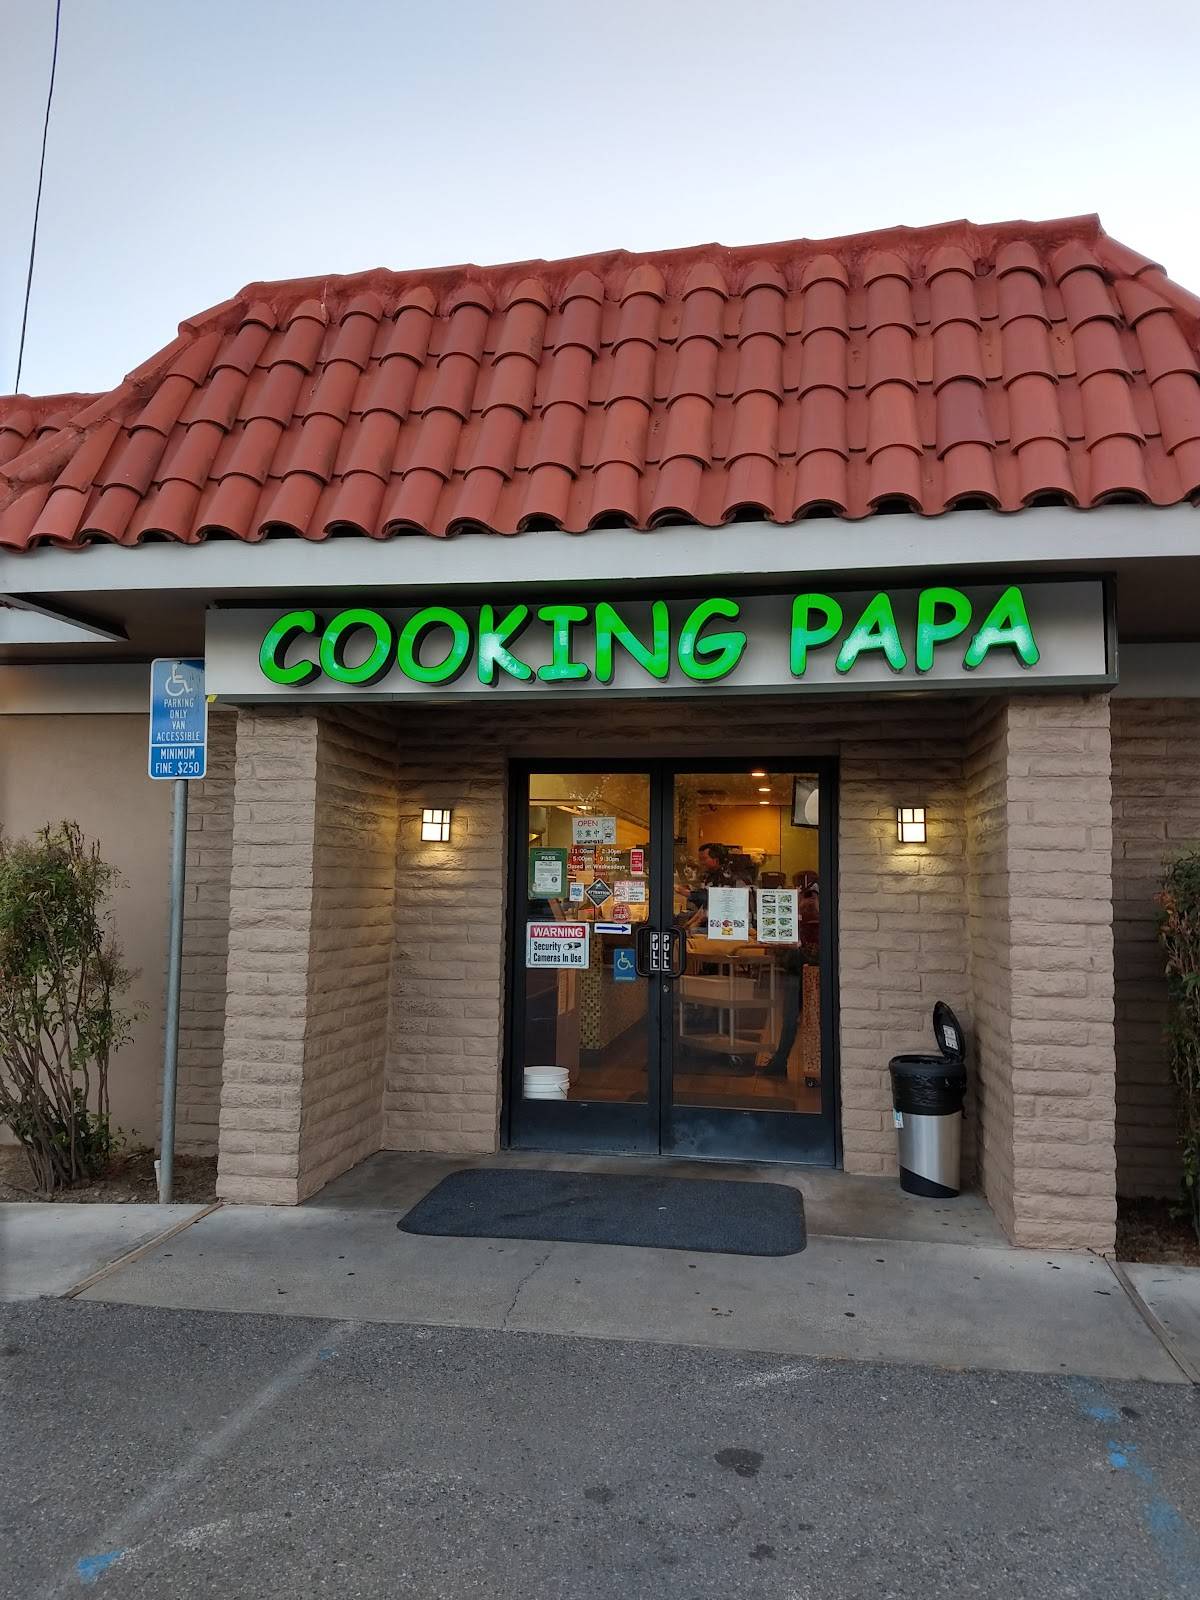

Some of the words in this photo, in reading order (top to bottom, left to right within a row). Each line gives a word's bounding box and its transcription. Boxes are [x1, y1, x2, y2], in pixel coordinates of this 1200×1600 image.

[258, 598, 747, 685] COOKING
[789, 586, 1040, 677] PAPA
[164, 699, 194, 708] PARKING
[169, 709, 188, 719] ONLY
[171, 720, 186, 730] VAN
[156, 731, 200, 741] ACCESSIBLE
[160, 748, 195, 760] MINIMUM
[155, 762, 173, 774] FINE
[177, 761, 200, 775] $250
[593, 863, 626, 871] Wednesdays
[533, 927, 583, 937] WARNING
[533, 941, 561, 952] Security
[533, 953, 561, 962] Cameras
[562, 953, 569, 962] In
[570, 953, 582, 962] Use
